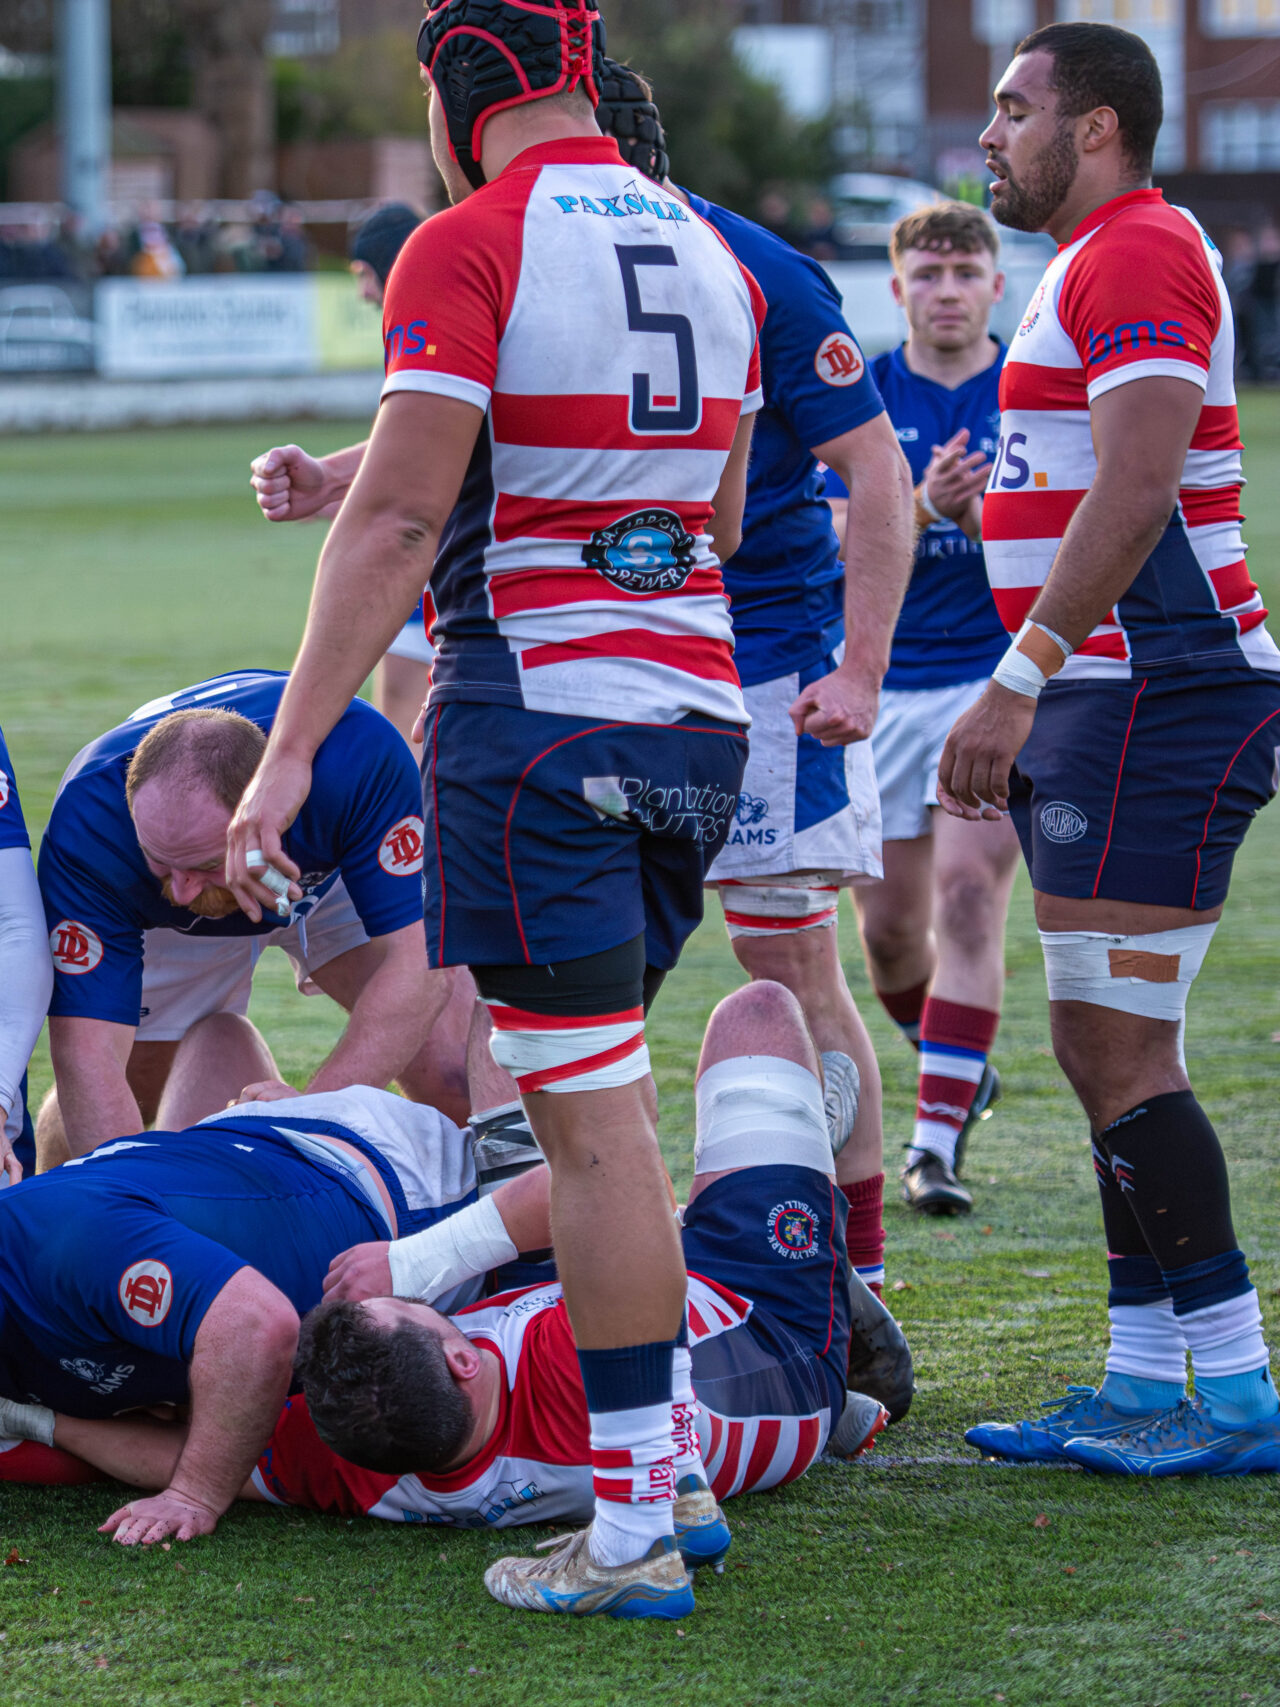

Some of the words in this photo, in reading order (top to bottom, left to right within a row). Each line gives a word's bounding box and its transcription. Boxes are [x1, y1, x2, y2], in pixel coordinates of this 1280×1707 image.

[614, 244, 702, 433] 5
[621, 777, 736, 817] Plantation
[725, 829, 778, 846] AMS
